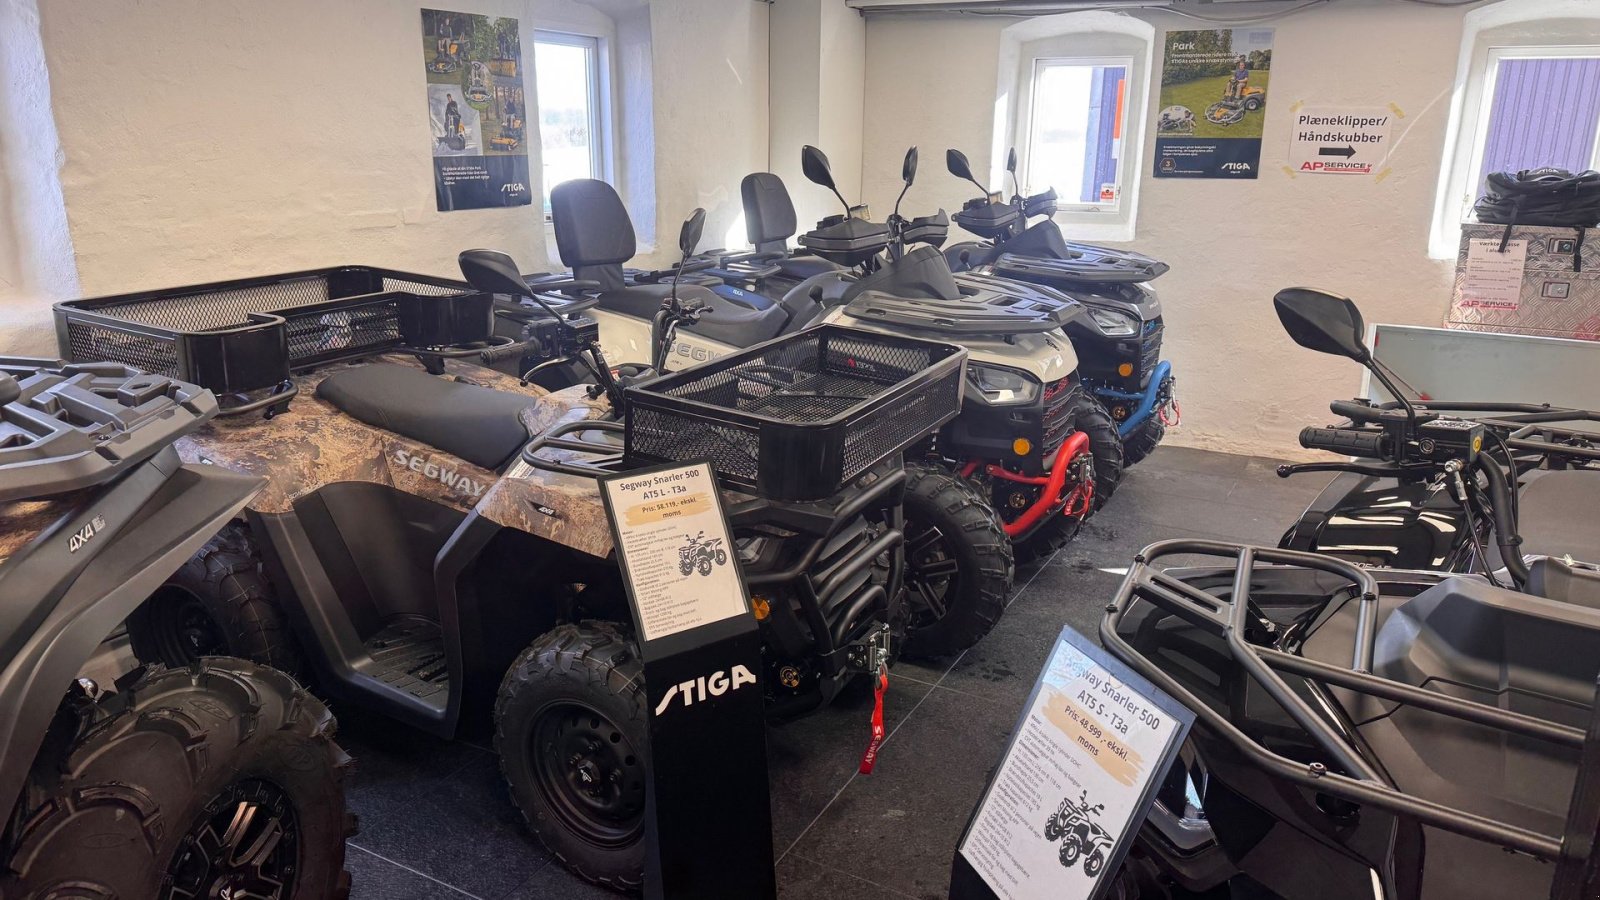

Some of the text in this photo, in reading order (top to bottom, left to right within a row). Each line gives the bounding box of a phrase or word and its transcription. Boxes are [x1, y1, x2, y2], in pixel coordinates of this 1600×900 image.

[1172, 42, 1195, 50] Park
[1299, 115, 1388, 128] Plæneklipper/
[1299, 131, 1382, 143] Håndskubber
[1300, 162, 1324, 170] AP
[501, 184, 524, 192] STIGA
[394, 450, 486, 496] SEGWAY
[620, 470, 700, 491] Segway Snarler 500
[643, 492, 659, 500] AT5
[672, 486, 687, 494] T3a
[70, 524, 94, 552] 4X4
[656, 664, 756, 716] STIGA
[1077, 690, 1097, 710] AT5
[1096, 704, 1105, 716] S
[1110, 712, 1128, 735] T3a
[1102, 682, 1140, 715] Snarler
[1139, 708, 1160, 730] 500
[1064, 705, 1080, 722] Pris:
[1080, 718, 1102, 739] 48.999
[1107, 740, 1128, 762] ekskl.
[865, 726, 881, 764] SEGWAY
[1078, 736, 1099, 756] moms
